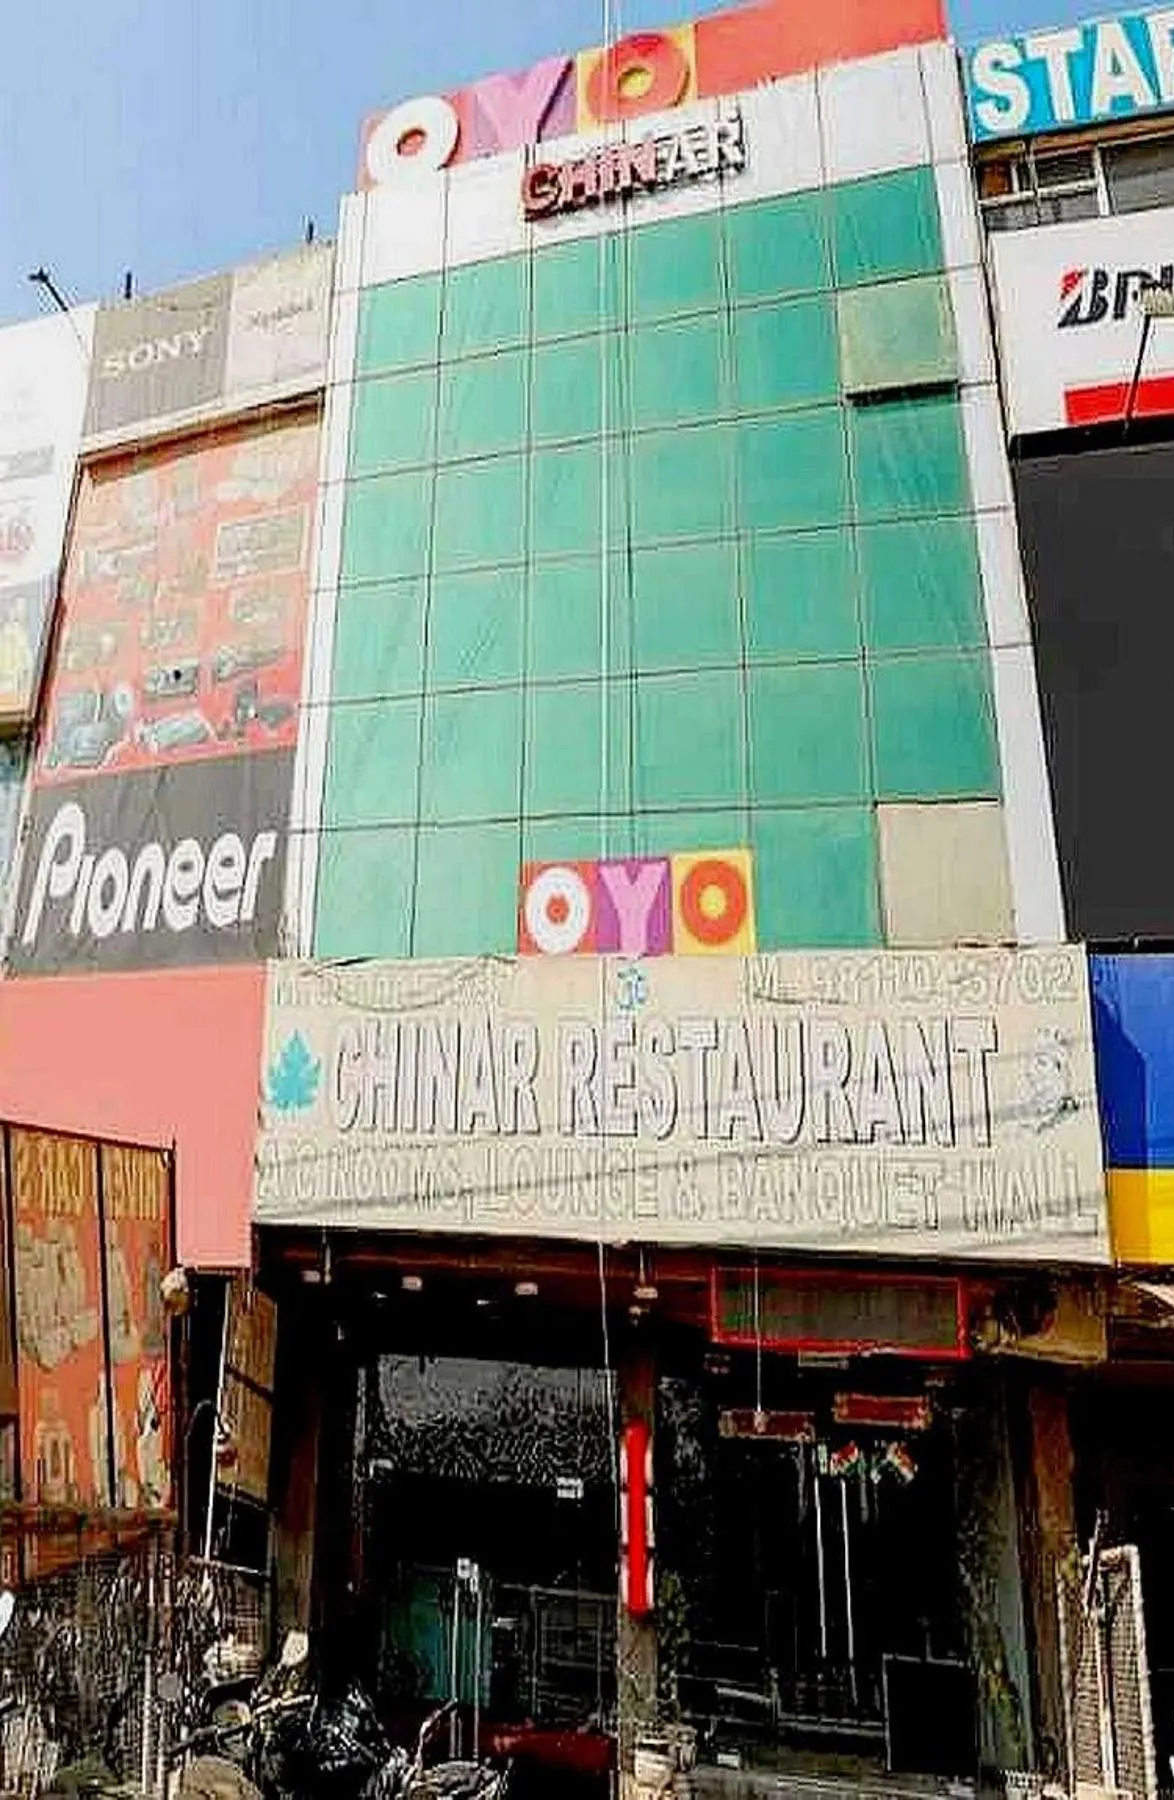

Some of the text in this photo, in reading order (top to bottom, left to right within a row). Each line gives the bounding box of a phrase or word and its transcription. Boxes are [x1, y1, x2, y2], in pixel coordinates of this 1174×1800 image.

[366, 32, 690, 186] OYO
[103, 324, 220, 381] SONY
[20, 802, 279, 948] Pioneer
[525, 858, 748, 955] OYO
[335, 1012, 999, 1148] CHINAR RESTAURANT
[482, 1142, 660, 1221] LOUNGE
[716, 1150, 943, 1234] BANQUET
